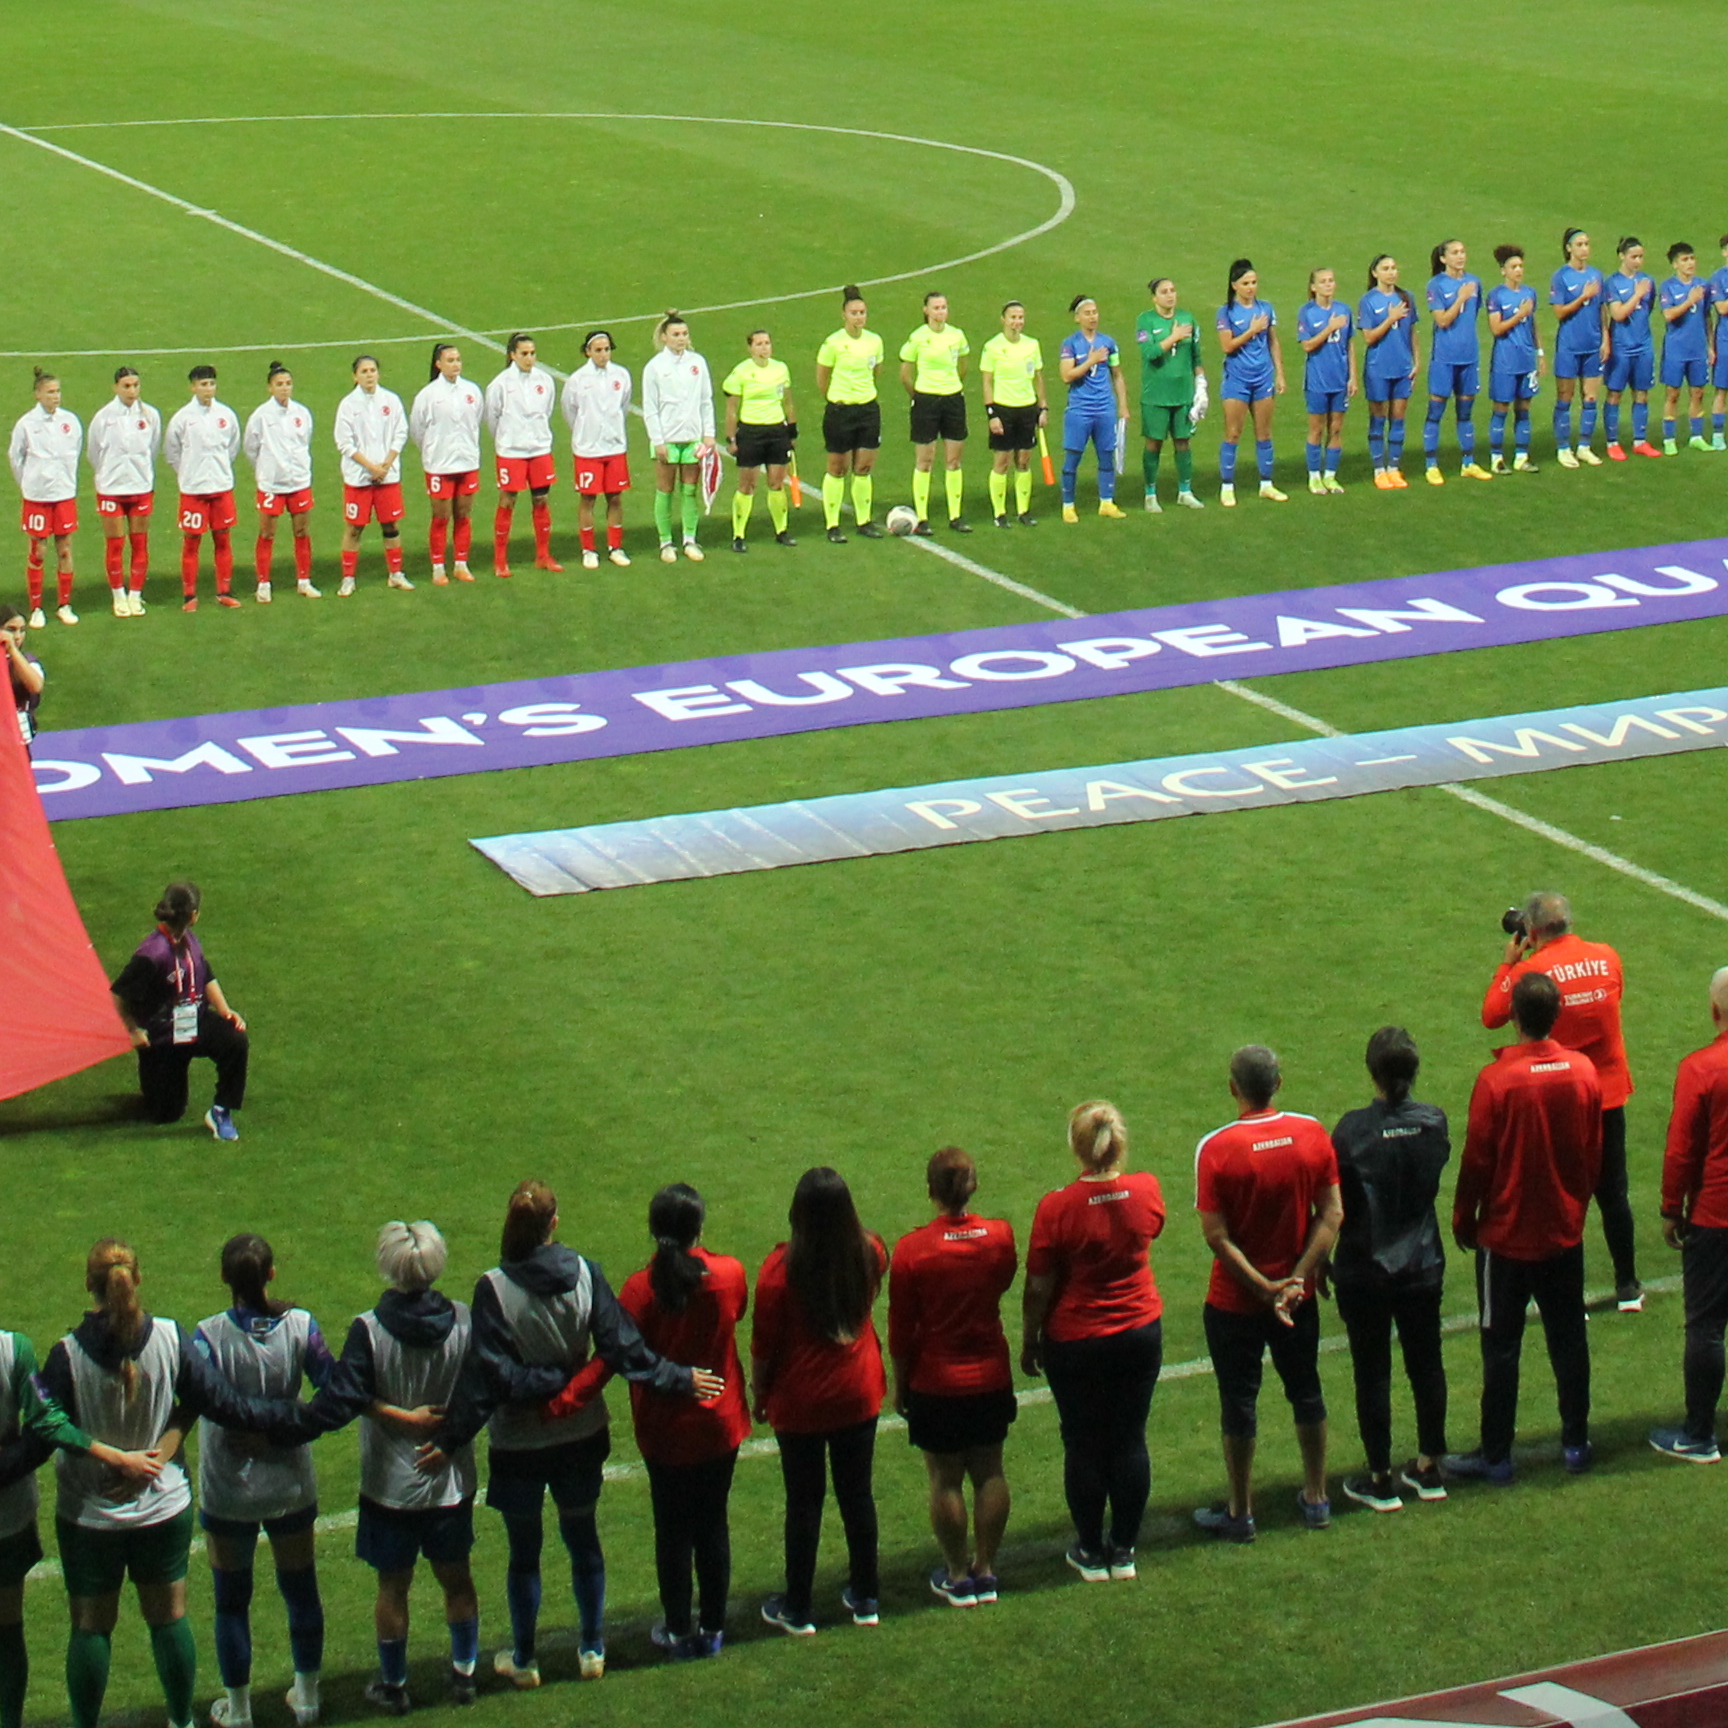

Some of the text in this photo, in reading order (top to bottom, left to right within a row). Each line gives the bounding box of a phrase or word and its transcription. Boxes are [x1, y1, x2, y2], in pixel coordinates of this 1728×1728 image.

[430, 476, 442, 493] 6
[499, 468, 511, 484] 5
[579, 472, 595, 488] 17
[262, 492, 276, 508] 2
[183, 510, 203, 529] 20
[345, 503, 359, 519] 19
[28, 514, 46, 531] 10
[31, 702, 607, 794] OMEN'S
[632, 598, 1486, 722] EUROPEAN
[903, 756, 1338, 832] PEACE
